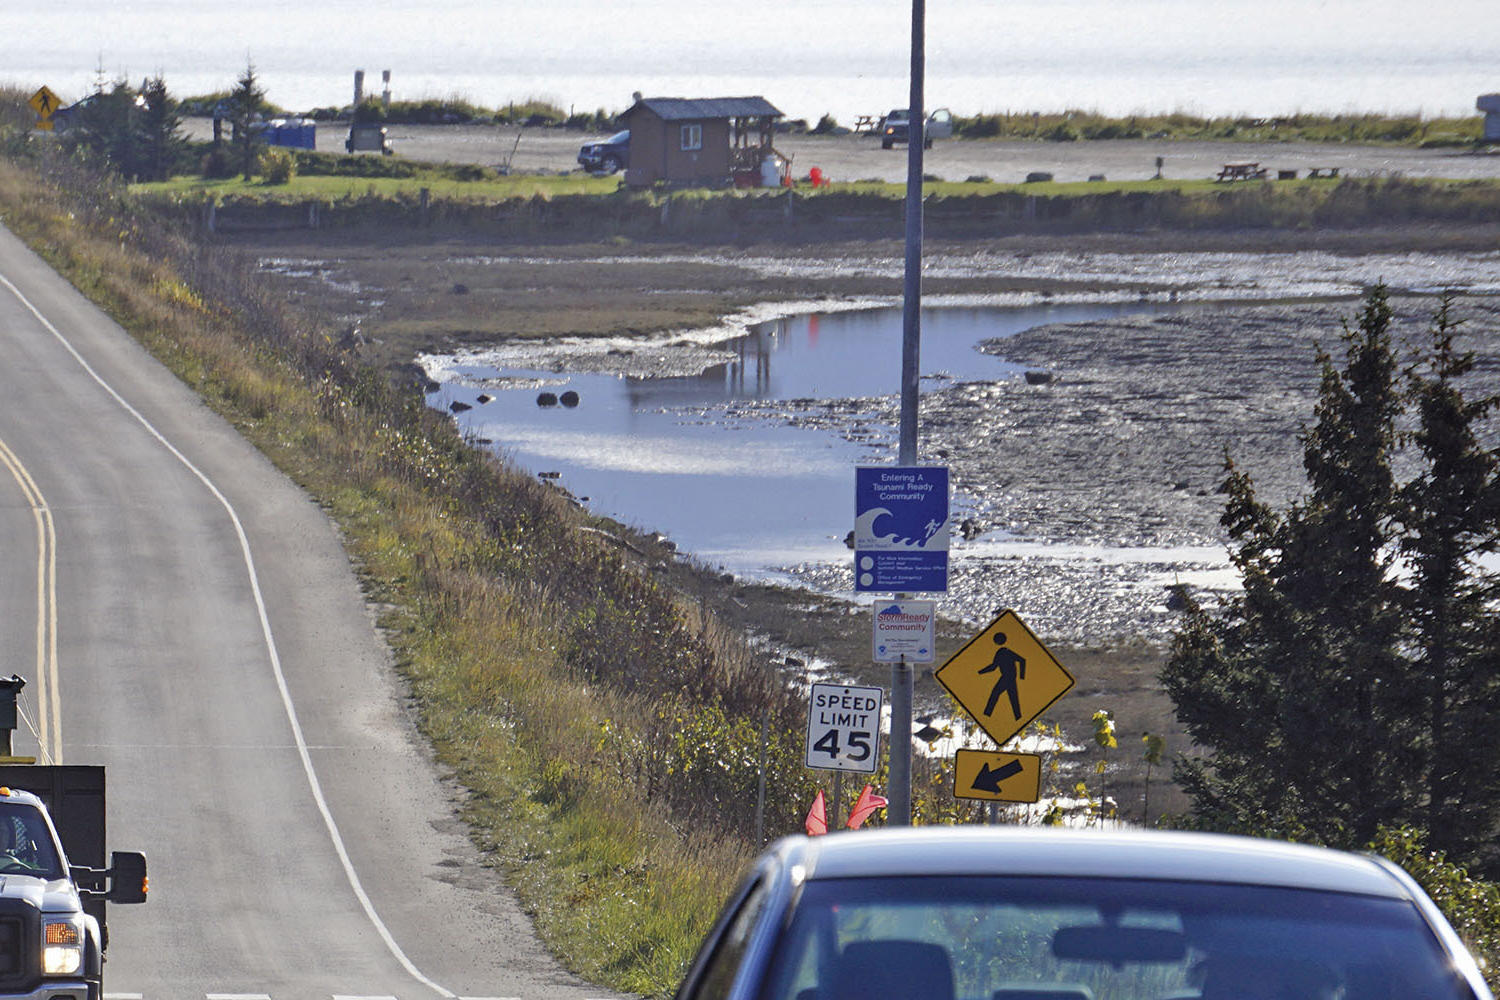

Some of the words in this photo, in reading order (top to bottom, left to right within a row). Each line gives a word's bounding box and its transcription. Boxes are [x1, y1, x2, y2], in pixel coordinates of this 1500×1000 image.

[881, 473, 915, 483] Entering
[872, 483, 905, 491] Tsunami
[907, 483, 934, 492] Ready
[879, 492, 926, 501] Community
[879, 623, 926, 632] Community
[816, 694, 877, 711] SPEED
[820, 711, 868, 728] LIMIT
[813, 729, 871, 762] 45
